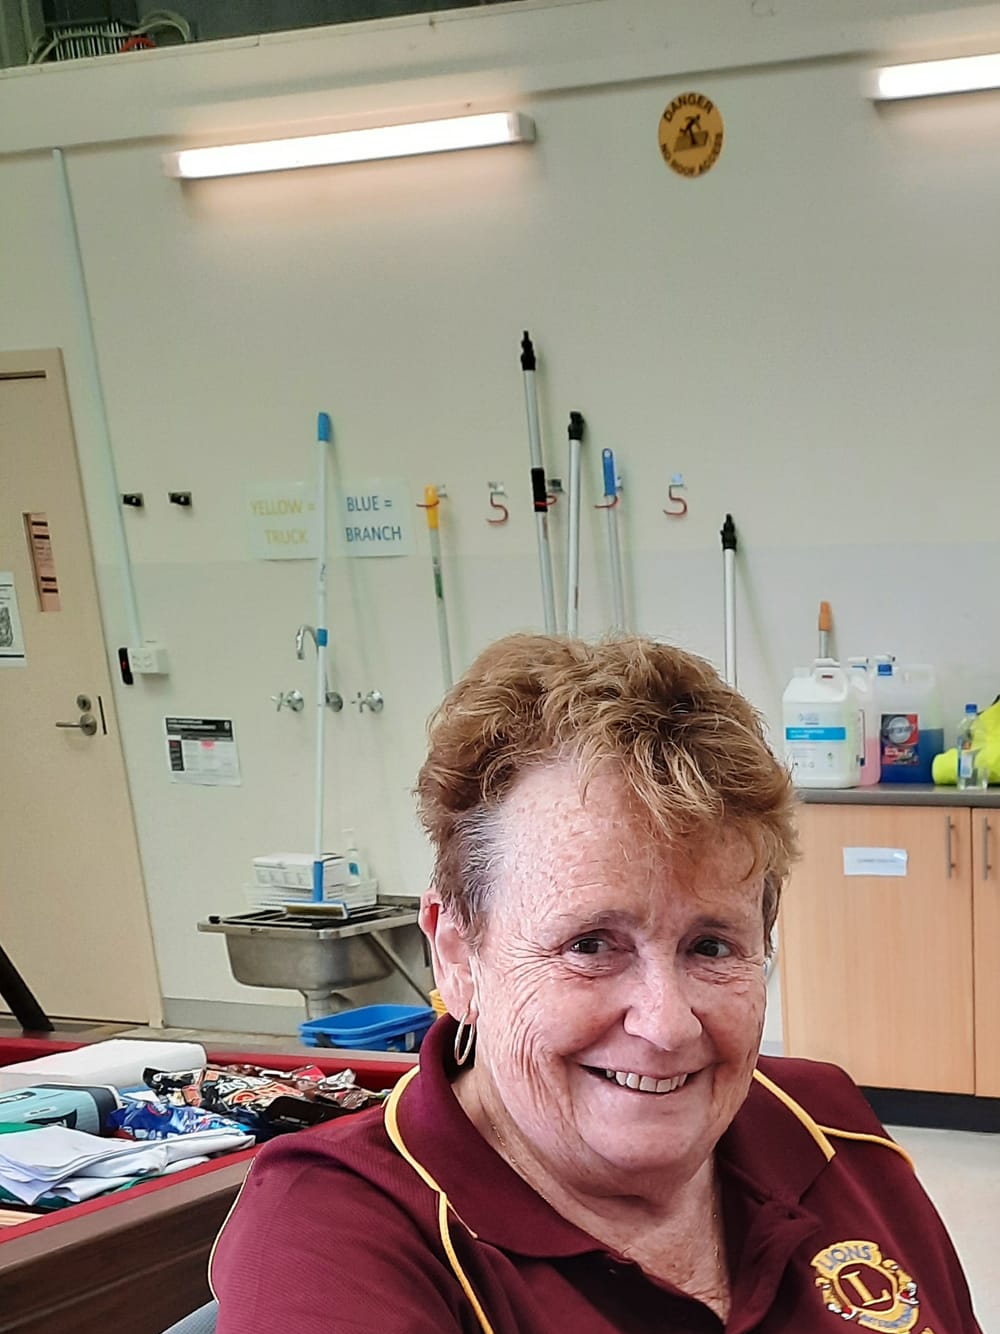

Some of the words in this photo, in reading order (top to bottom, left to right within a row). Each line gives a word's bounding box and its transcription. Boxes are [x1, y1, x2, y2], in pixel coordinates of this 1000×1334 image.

[663, 93, 714, 123] DANGER
[252, 499, 303, 515] YELLOW
[346, 496, 380, 512] BLUE
[264, 528, 308, 545] TRUCK
[345, 525, 402, 543] BRANCH
[816, 1244, 872, 1271] LIONS
[841, 1270, 892, 1307] L
